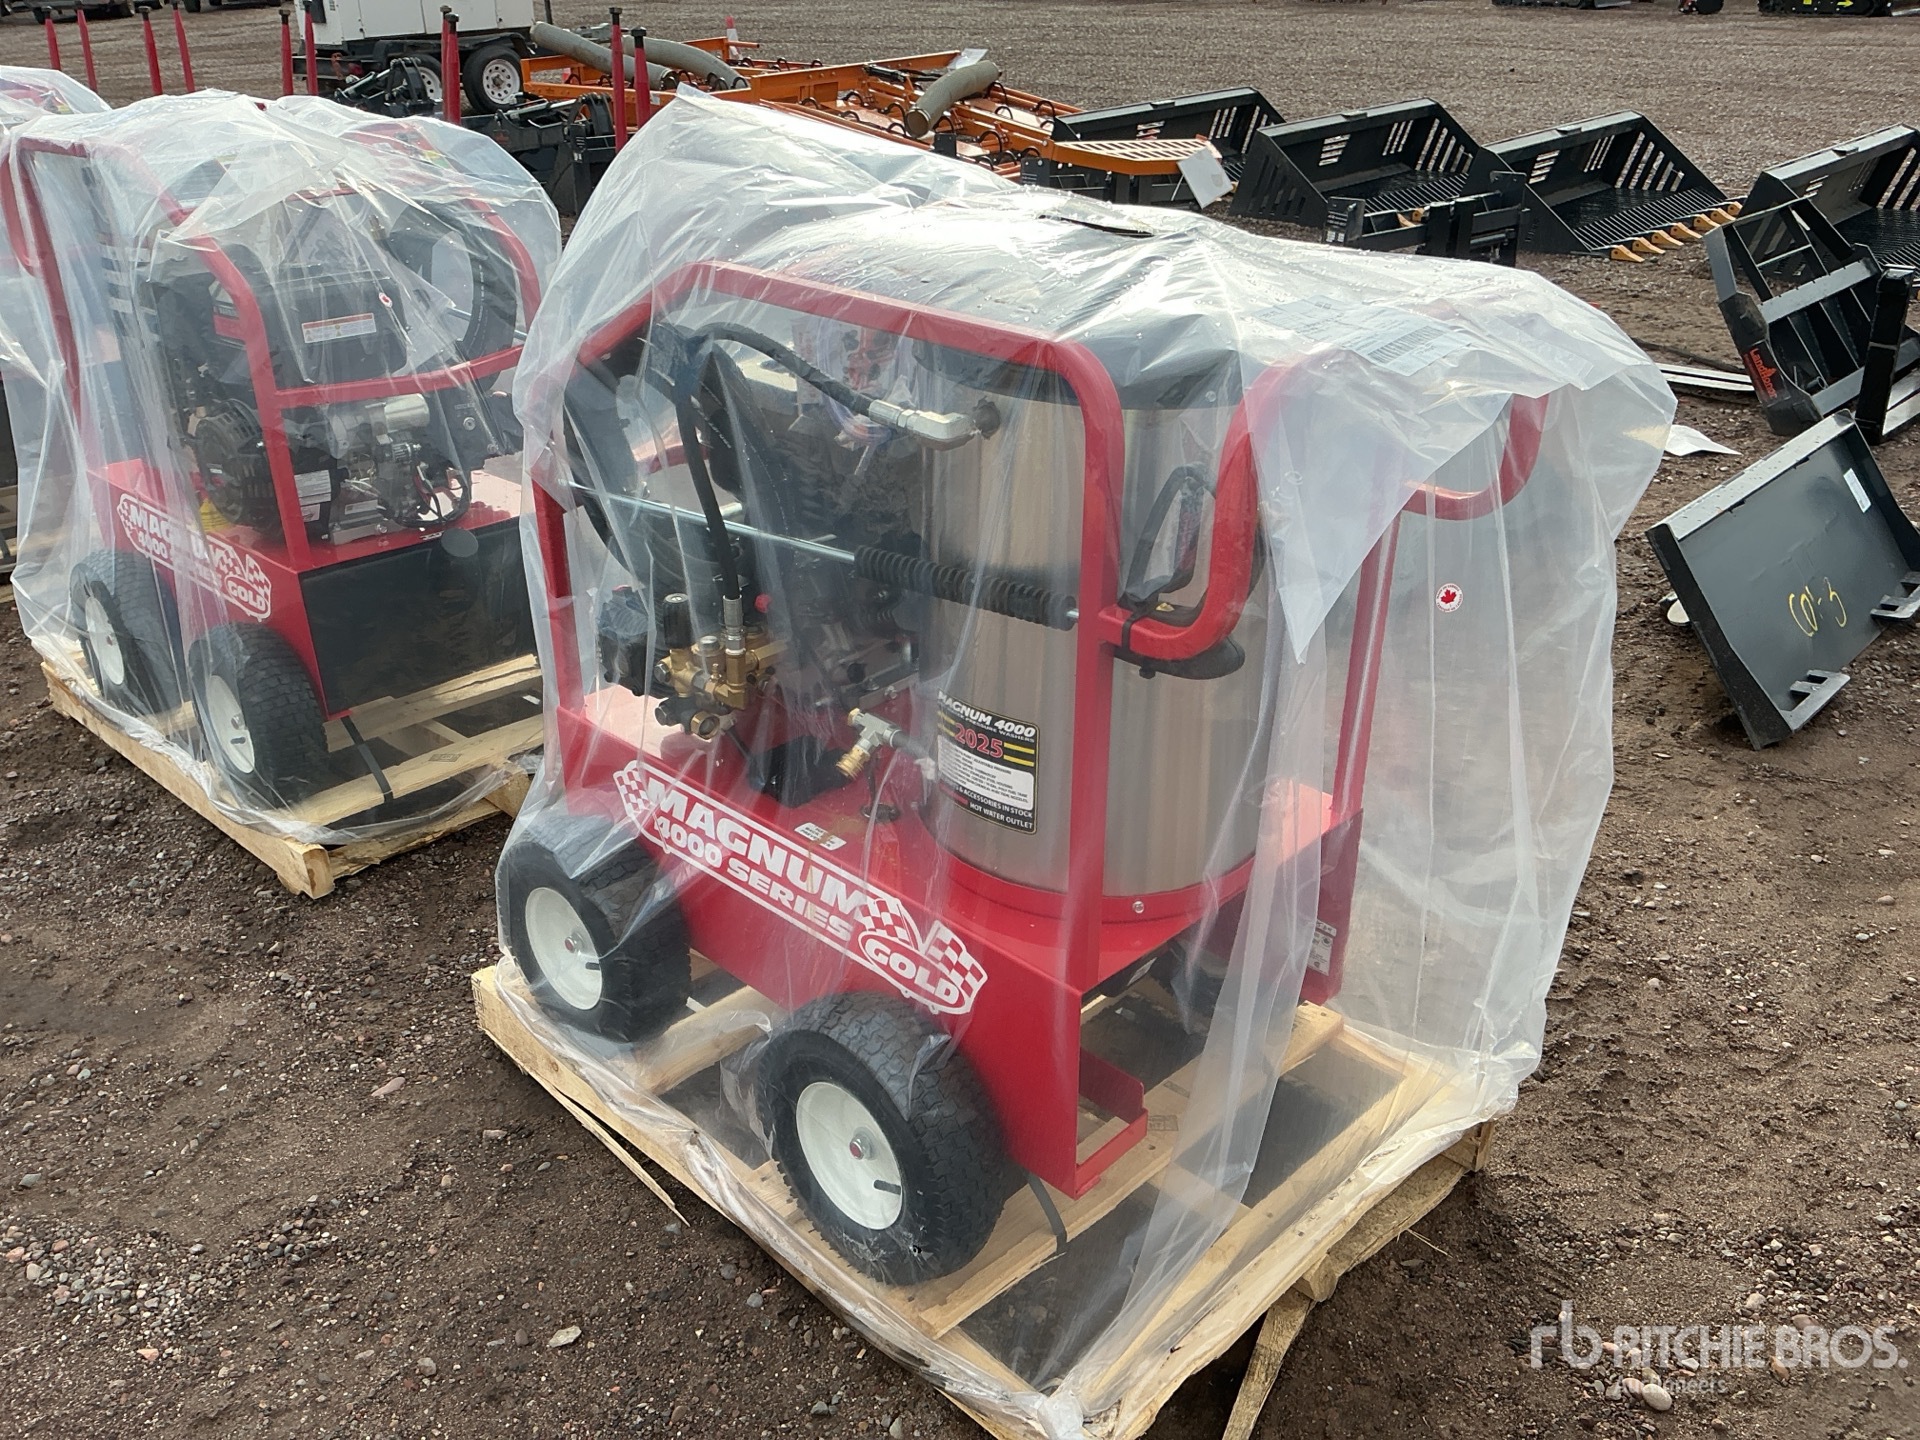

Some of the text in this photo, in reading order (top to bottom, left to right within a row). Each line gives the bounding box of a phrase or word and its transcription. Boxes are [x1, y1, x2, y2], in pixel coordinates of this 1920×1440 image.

[227, 580, 266, 612] GOLD
[938, 690, 993, 726] MAGNUM
[994, 719, 1036, 738] 4000
[954, 722, 1004, 758] 2025
[964, 788, 1002, 810] ACCESSORIES
[1002, 804, 1010, 813] IN
[1010, 807, 1033, 819] STOCK
[969, 802, 1033, 829] HOT WATER OUTLET
[649, 775, 863, 916] MAGNUM
[653, 814, 853, 942] 4000 SERIES
[863, 937, 960, 1005] GOLD
